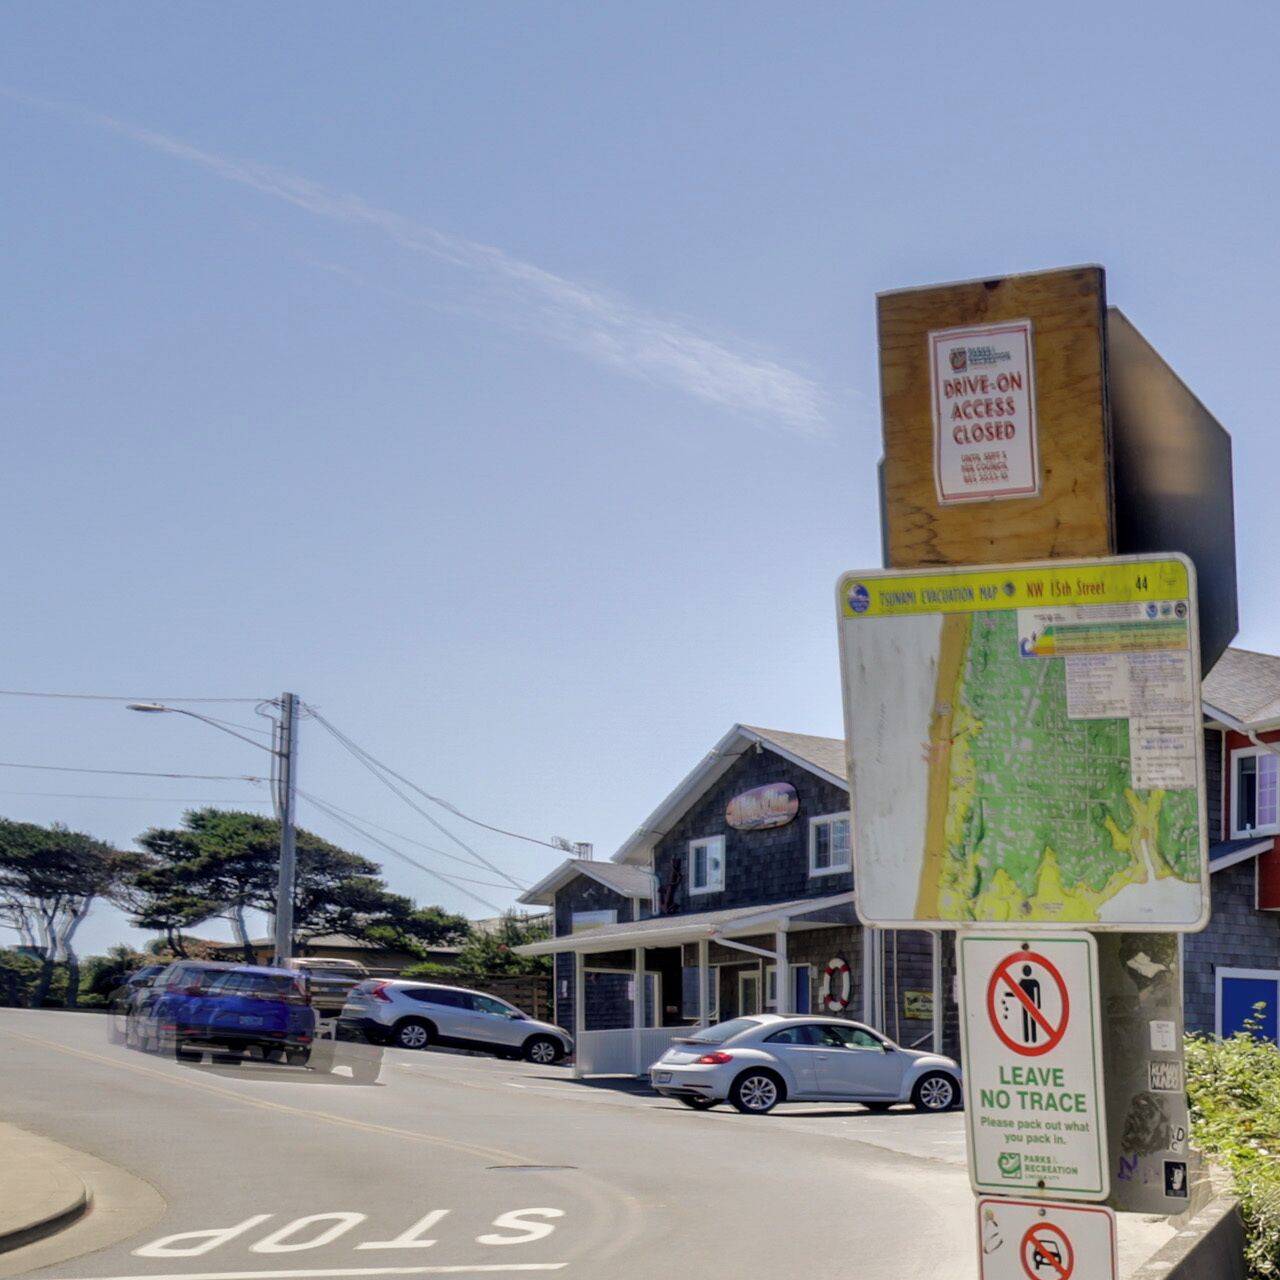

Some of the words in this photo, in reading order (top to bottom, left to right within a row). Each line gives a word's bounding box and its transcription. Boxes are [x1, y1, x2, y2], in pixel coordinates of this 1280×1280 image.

[943, 371, 1023, 398] DRIVE-ON
[951, 396, 1016, 421] ACCESS
[952, 421, 1015, 445] CLOSED
[879, 590, 916, 606] TSUNAMI
[921, 586, 974, 604] EVACUATION
[979, 584, 998, 600] MAP
[1026, 582, 1044, 598] NW
[1051, 580, 1072, 597] 15th
[1076, 579, 1105, 595] Street
[1136, 576, 1148, 592] 44
[999, 1066, 1065, 1087] LEAVE
[980, 1089, 1011, 1109] NO
[1016, 1091, 1087, 1112] TRACE
[980, 1116, 1015, 1128] Please
[1017, 1119, 1042, 1131] pack
[1045, 1120, 1062, 1131] out
[1064, 1121, 1090, 1132] what
[1004, 1134, 1023, 1144] you
[1026, 1133, 1051, 1145] pack
[1053, 1134, 1067, 1145] in.
[1023, 1155, 1051, 1164] PARKS
[1024, 1164, 1078, 1175] RECREATION
[131, 1207, 566, 1258] STOP
